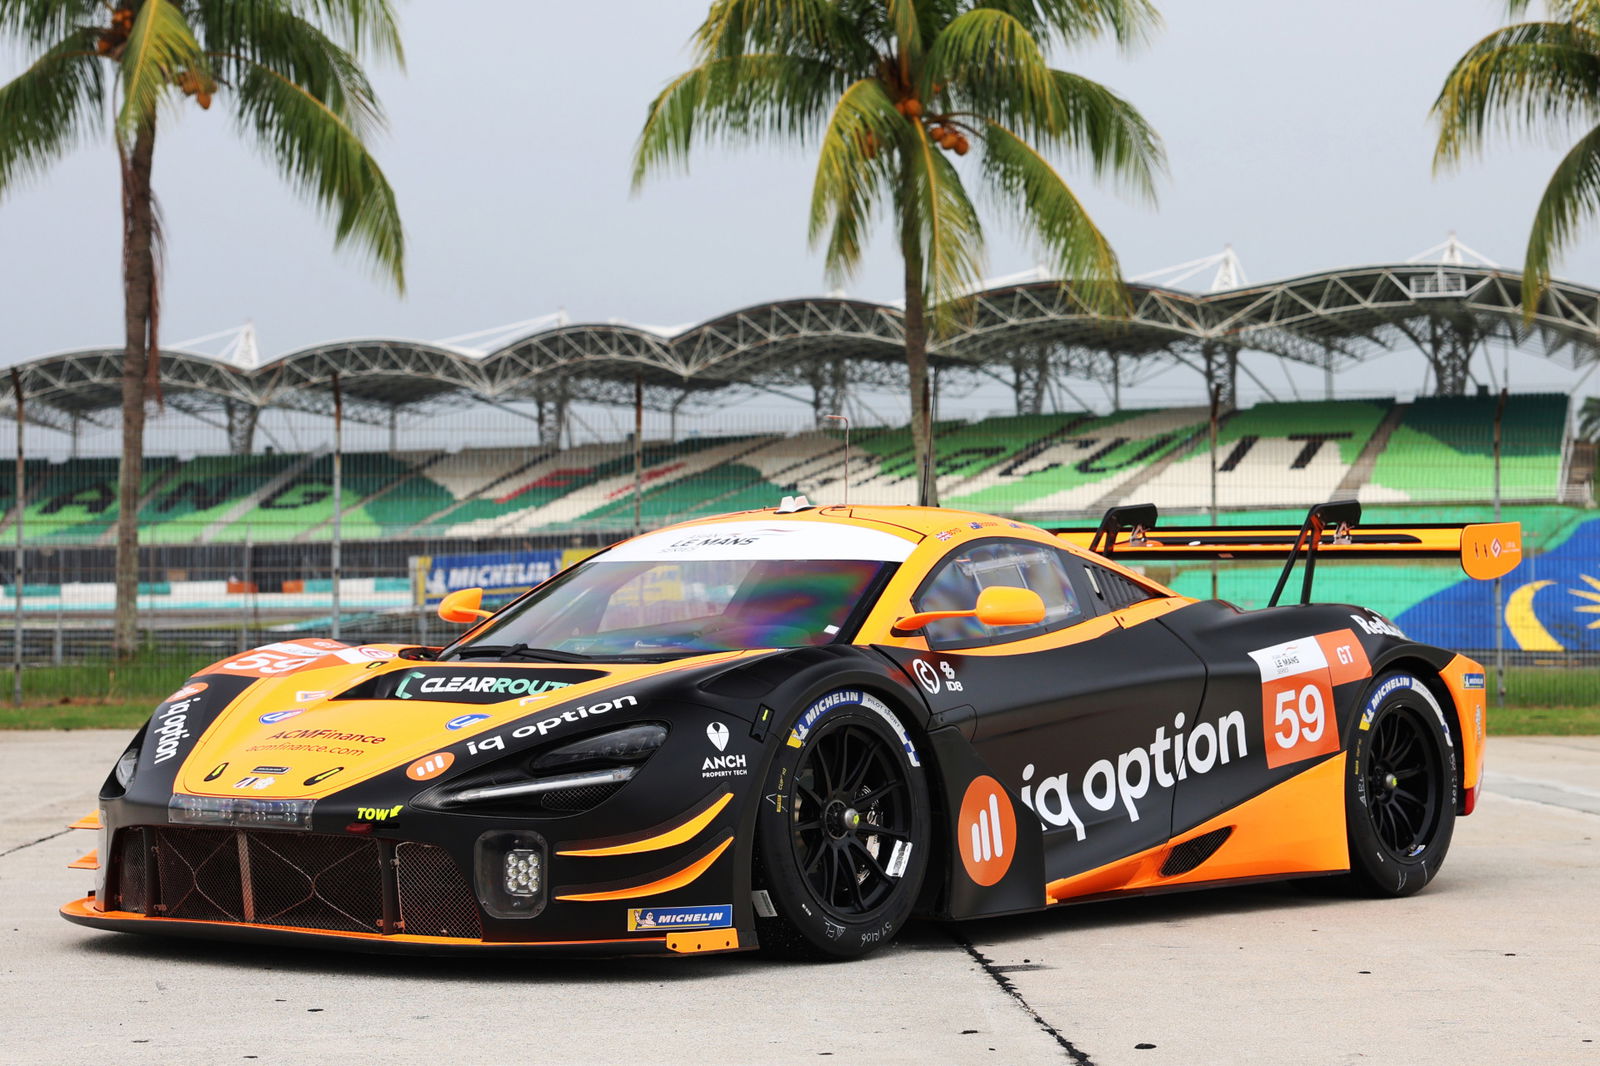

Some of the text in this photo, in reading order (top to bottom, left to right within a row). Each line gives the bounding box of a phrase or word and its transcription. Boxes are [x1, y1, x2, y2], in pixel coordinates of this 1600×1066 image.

[450, 561, 550, 589] MICHELIN
[223, 653, 319, 674] 59
[1336, 645, 1354, 665] GT
[1371, 677, 1410, 711] MICHELIN
[805, 691, 859, 726] MICHELIN
[1274, 684, 1325, 749] 59
[154, 697, 201, 764] iq option
[466, 695, 638, 756] iq option
[266, 729, 386, 745] ACMFinance
[246, 742, 365, 757] acmfinance.com
[702, 754, 747, 771] ANCH
[702, 770, 732, 778] PROPERTY
[1021, 711, 1248, 842] iq option
[357, 807, 389, 821] TOW
[658, 912, 724, 924] MICHELIN
